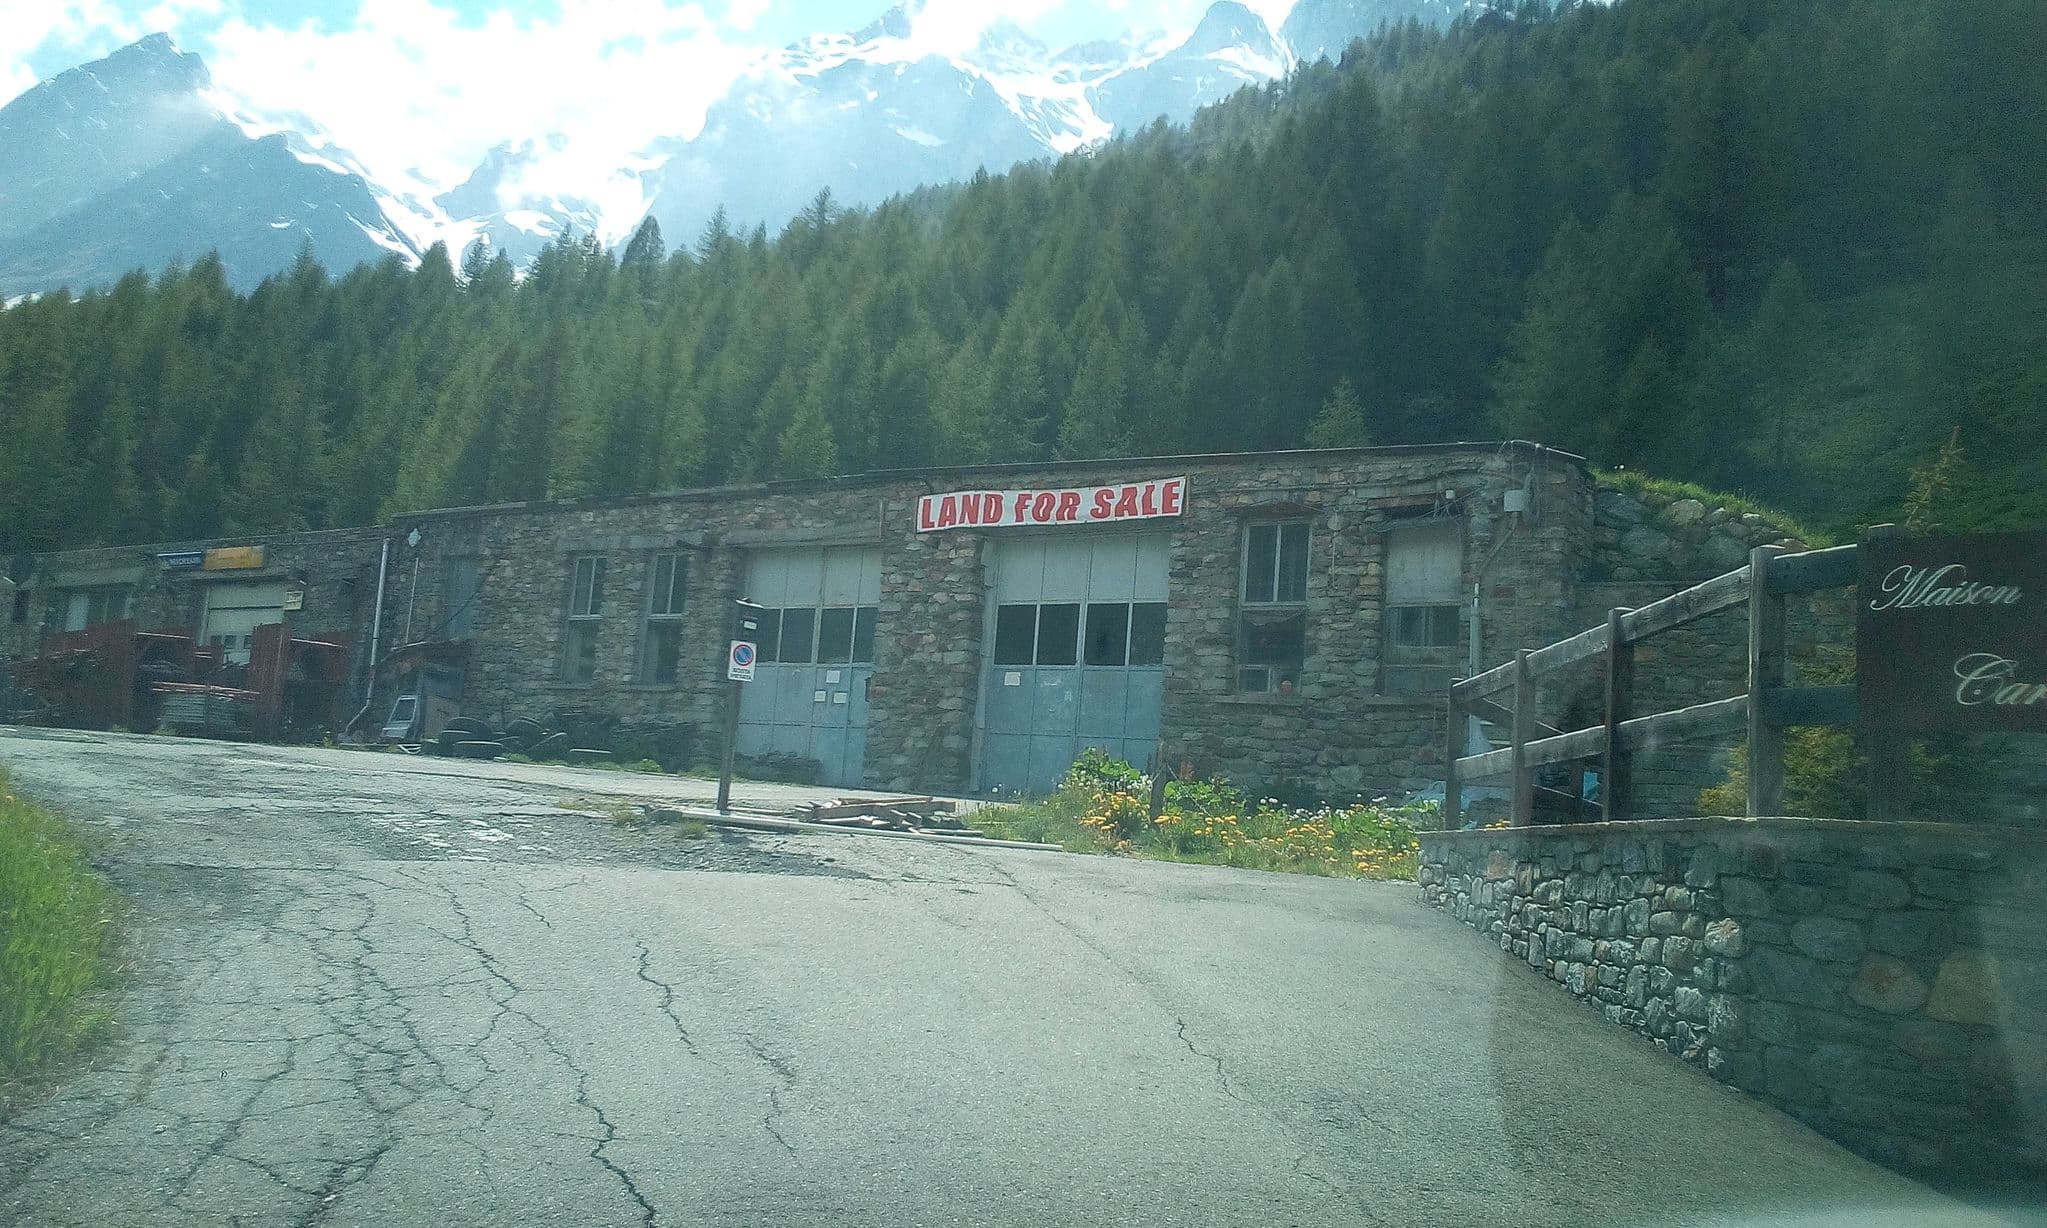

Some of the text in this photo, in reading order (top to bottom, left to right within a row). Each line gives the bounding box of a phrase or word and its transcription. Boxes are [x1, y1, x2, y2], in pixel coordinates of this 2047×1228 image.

[921, 480, 1181, 529] LAND FOR SALE
[1870, 563, 2023, 611] Maison
